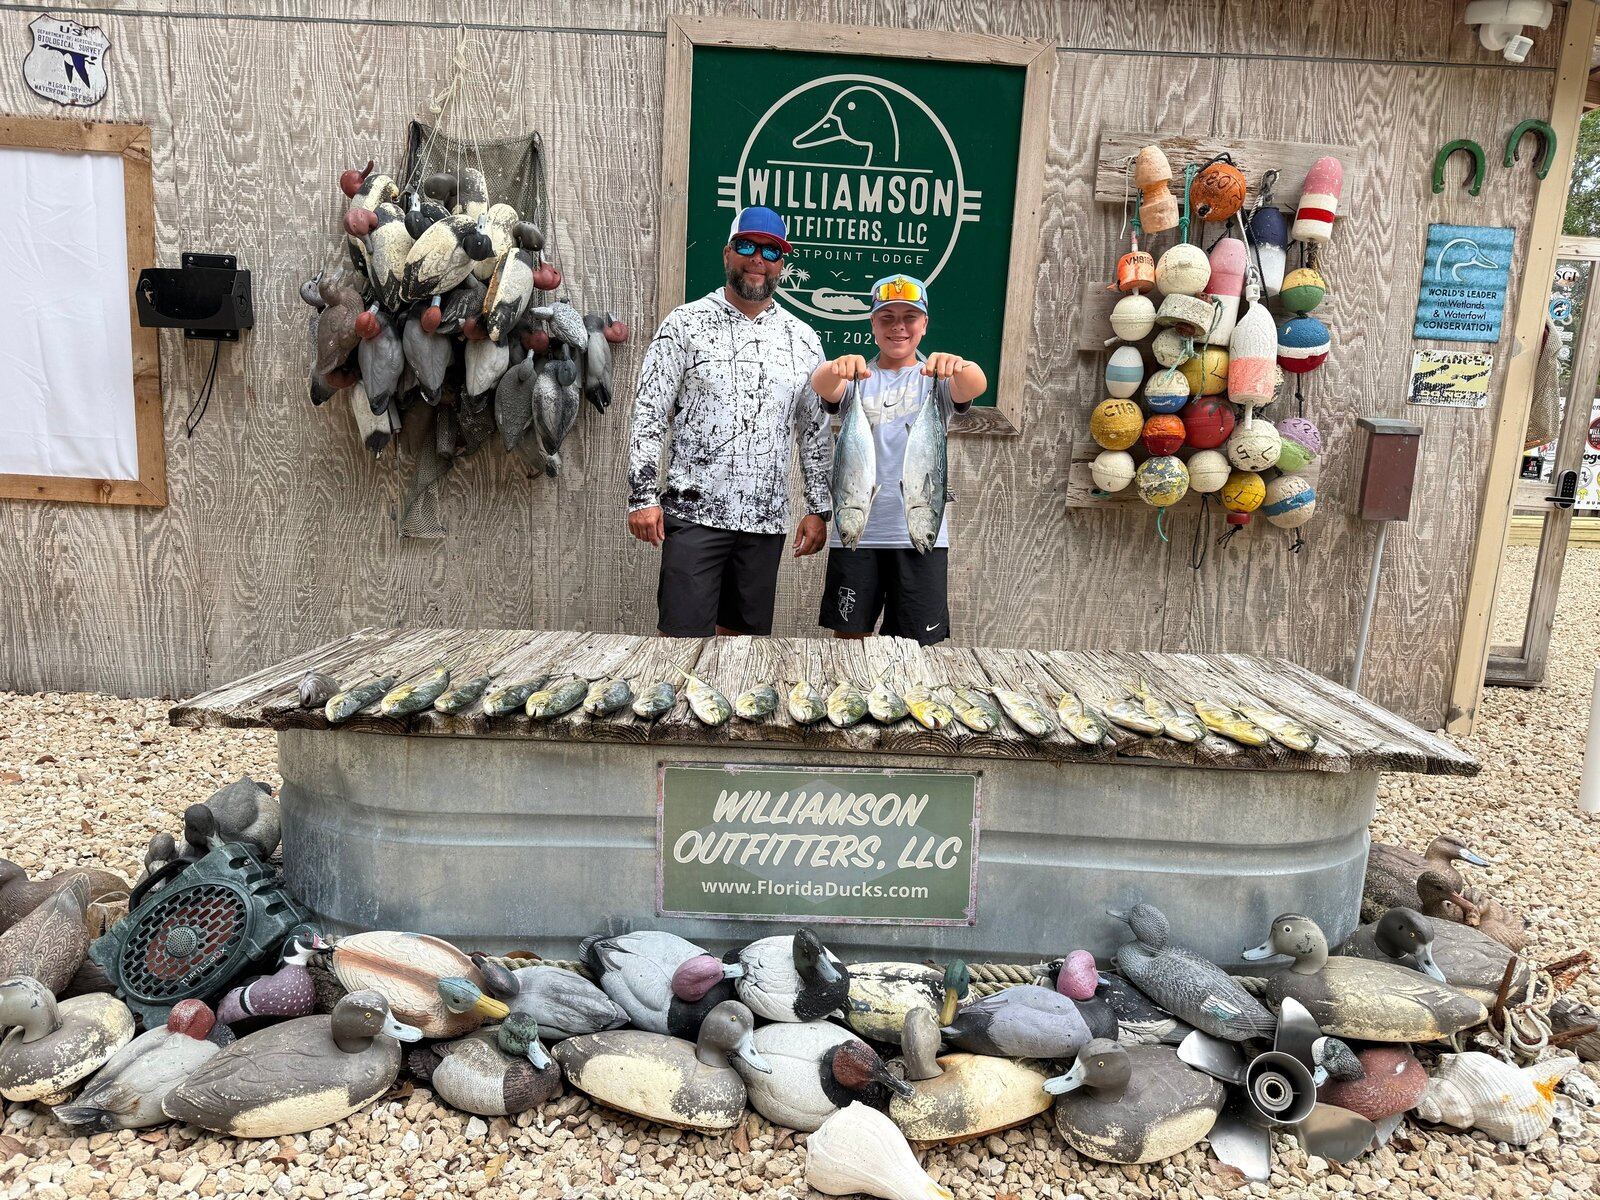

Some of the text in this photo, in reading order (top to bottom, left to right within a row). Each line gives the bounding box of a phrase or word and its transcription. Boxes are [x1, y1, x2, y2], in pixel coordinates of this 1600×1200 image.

[37, 35, 102, 56] BIOLOGICAL SURVEY
[47, 81, 82, 94] MIGRATORY
[748, 167, 954, 217] WILLIAMSON
[781, 214, 928, 246] UTFITTERS, LLC
[872, 253, 924, 265] LODGE
[1554, 270, 1579, 281] SGI
[1428, 288, 1497, 299] WORLD'S LEADER
[1449, 300, 1485, 310] Wetlands
[1433, 310, 1487, 320] & Waterfowl
[1422, 320, 1493, 333] CONSERVATION
[843, 331, 879, 346] 202
[712, 789, 930, 827] WILLIAMSON
[673, 830, 963, 870] OUTFITTERS, LLC
[701, 879, 929, 899] www.FloridaDucks.com
